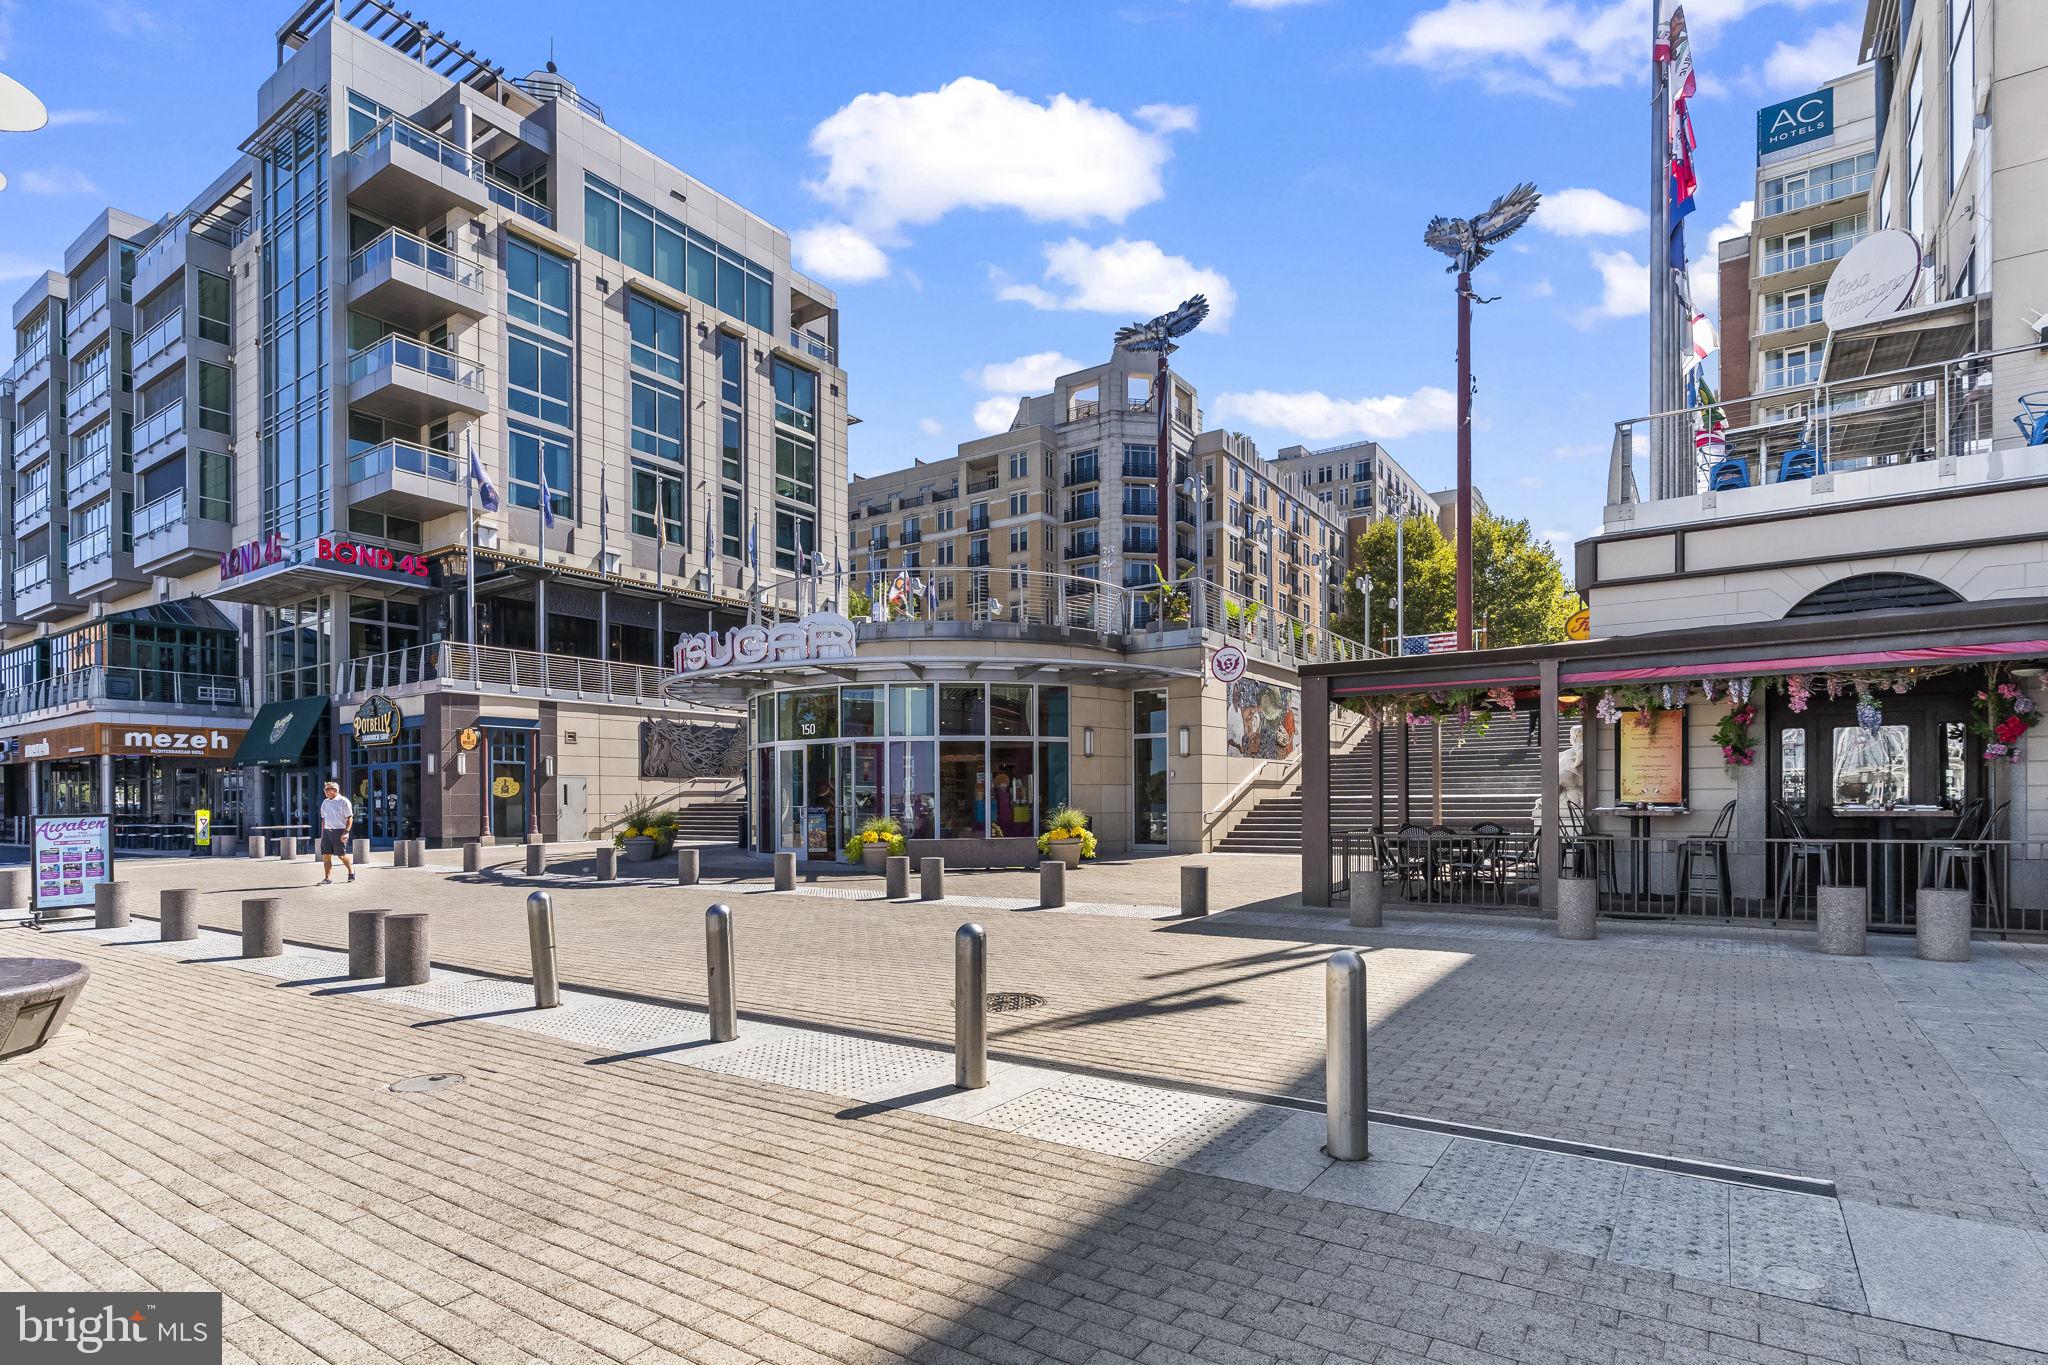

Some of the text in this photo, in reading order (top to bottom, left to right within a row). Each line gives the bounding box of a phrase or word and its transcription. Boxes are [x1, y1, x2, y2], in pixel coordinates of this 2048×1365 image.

[1770, 99, 1824, 133] AC
[1769, 121, 1824, 144] HOTELS
[1830, 273, 1870, 301] Rosa
[220, 531, 282, 581] BOND 45
[318, 537, 429, 577] BOND 45
[353, 710, 392, 738] POTBELLY
[801, 723, 816, 735] 150
[124, 731, 229, 749] mezeh
[36, 818, 107, 840] Awaken
